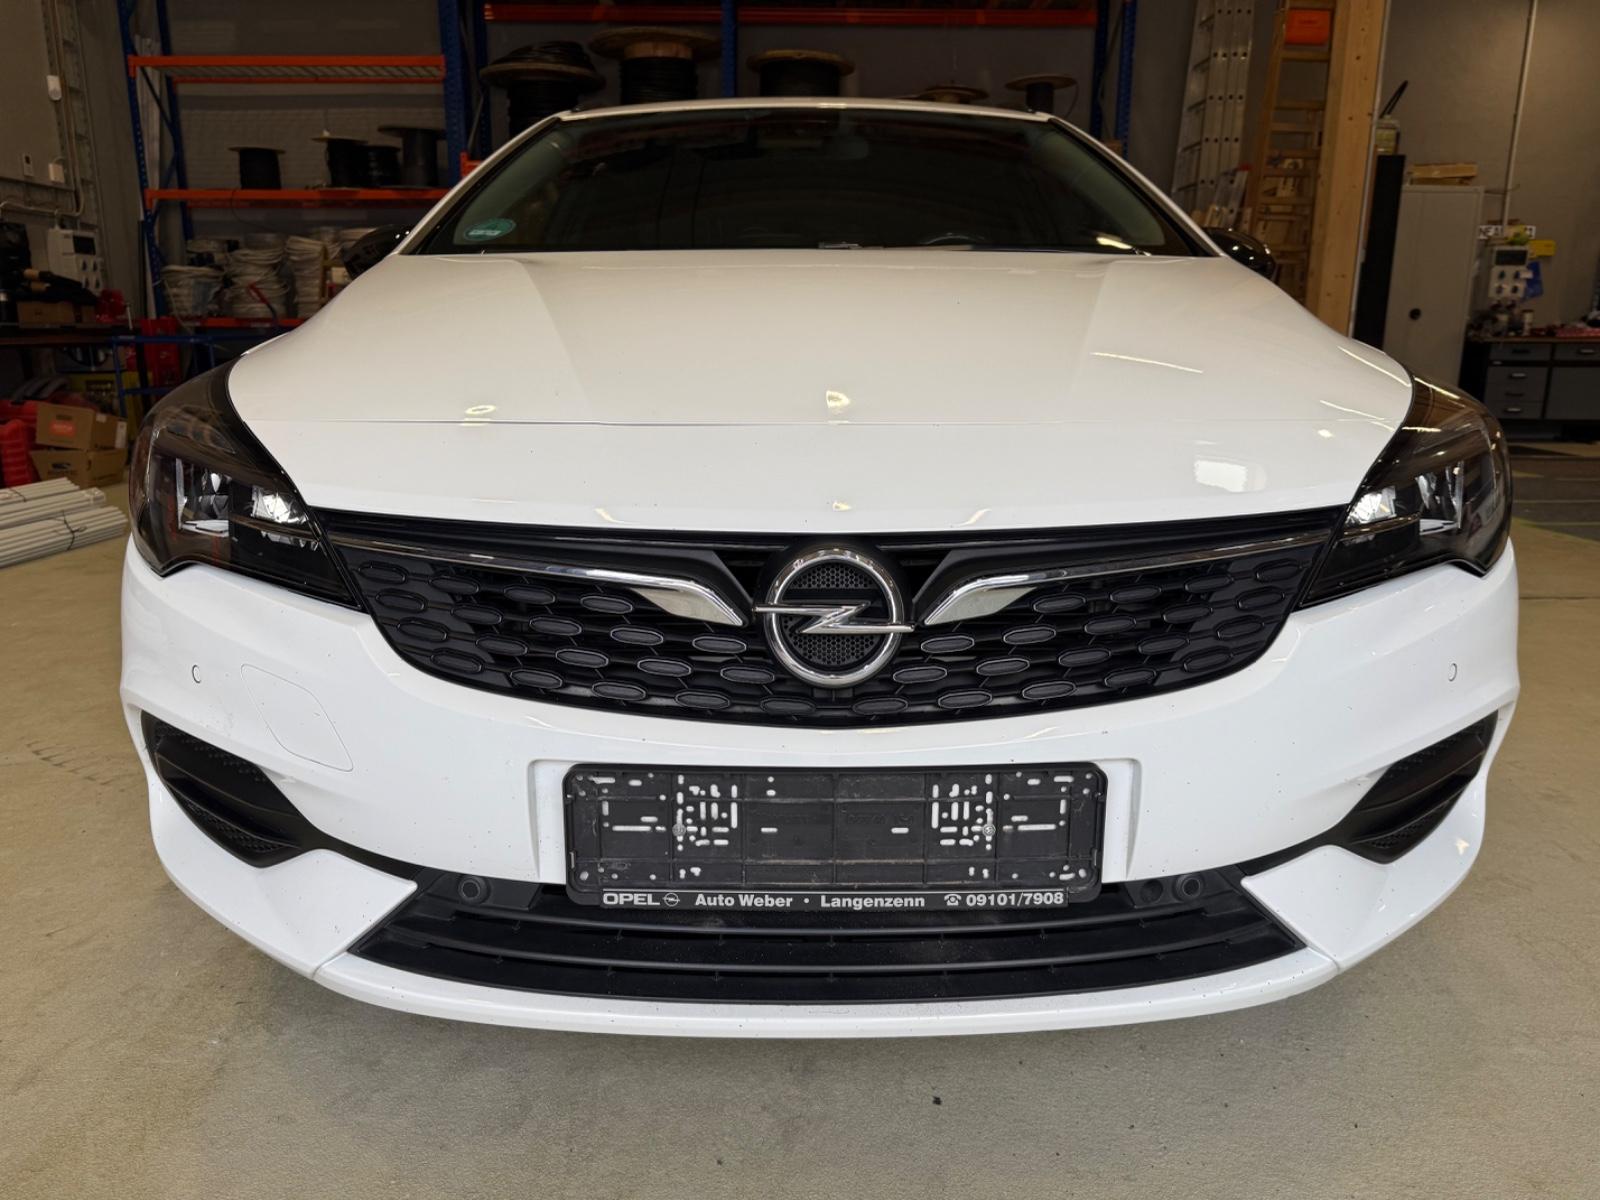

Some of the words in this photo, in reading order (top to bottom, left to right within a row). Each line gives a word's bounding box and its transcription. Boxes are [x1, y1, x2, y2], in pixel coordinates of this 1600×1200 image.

[603, 893, 660, 905] OPEL
[695, 893, 735, 907] Auto
[738, 894, 793, 907] Weber
[820, 895, 925, 910] Langenzenn
[966, 892, 1064, 906] 09101/7908
